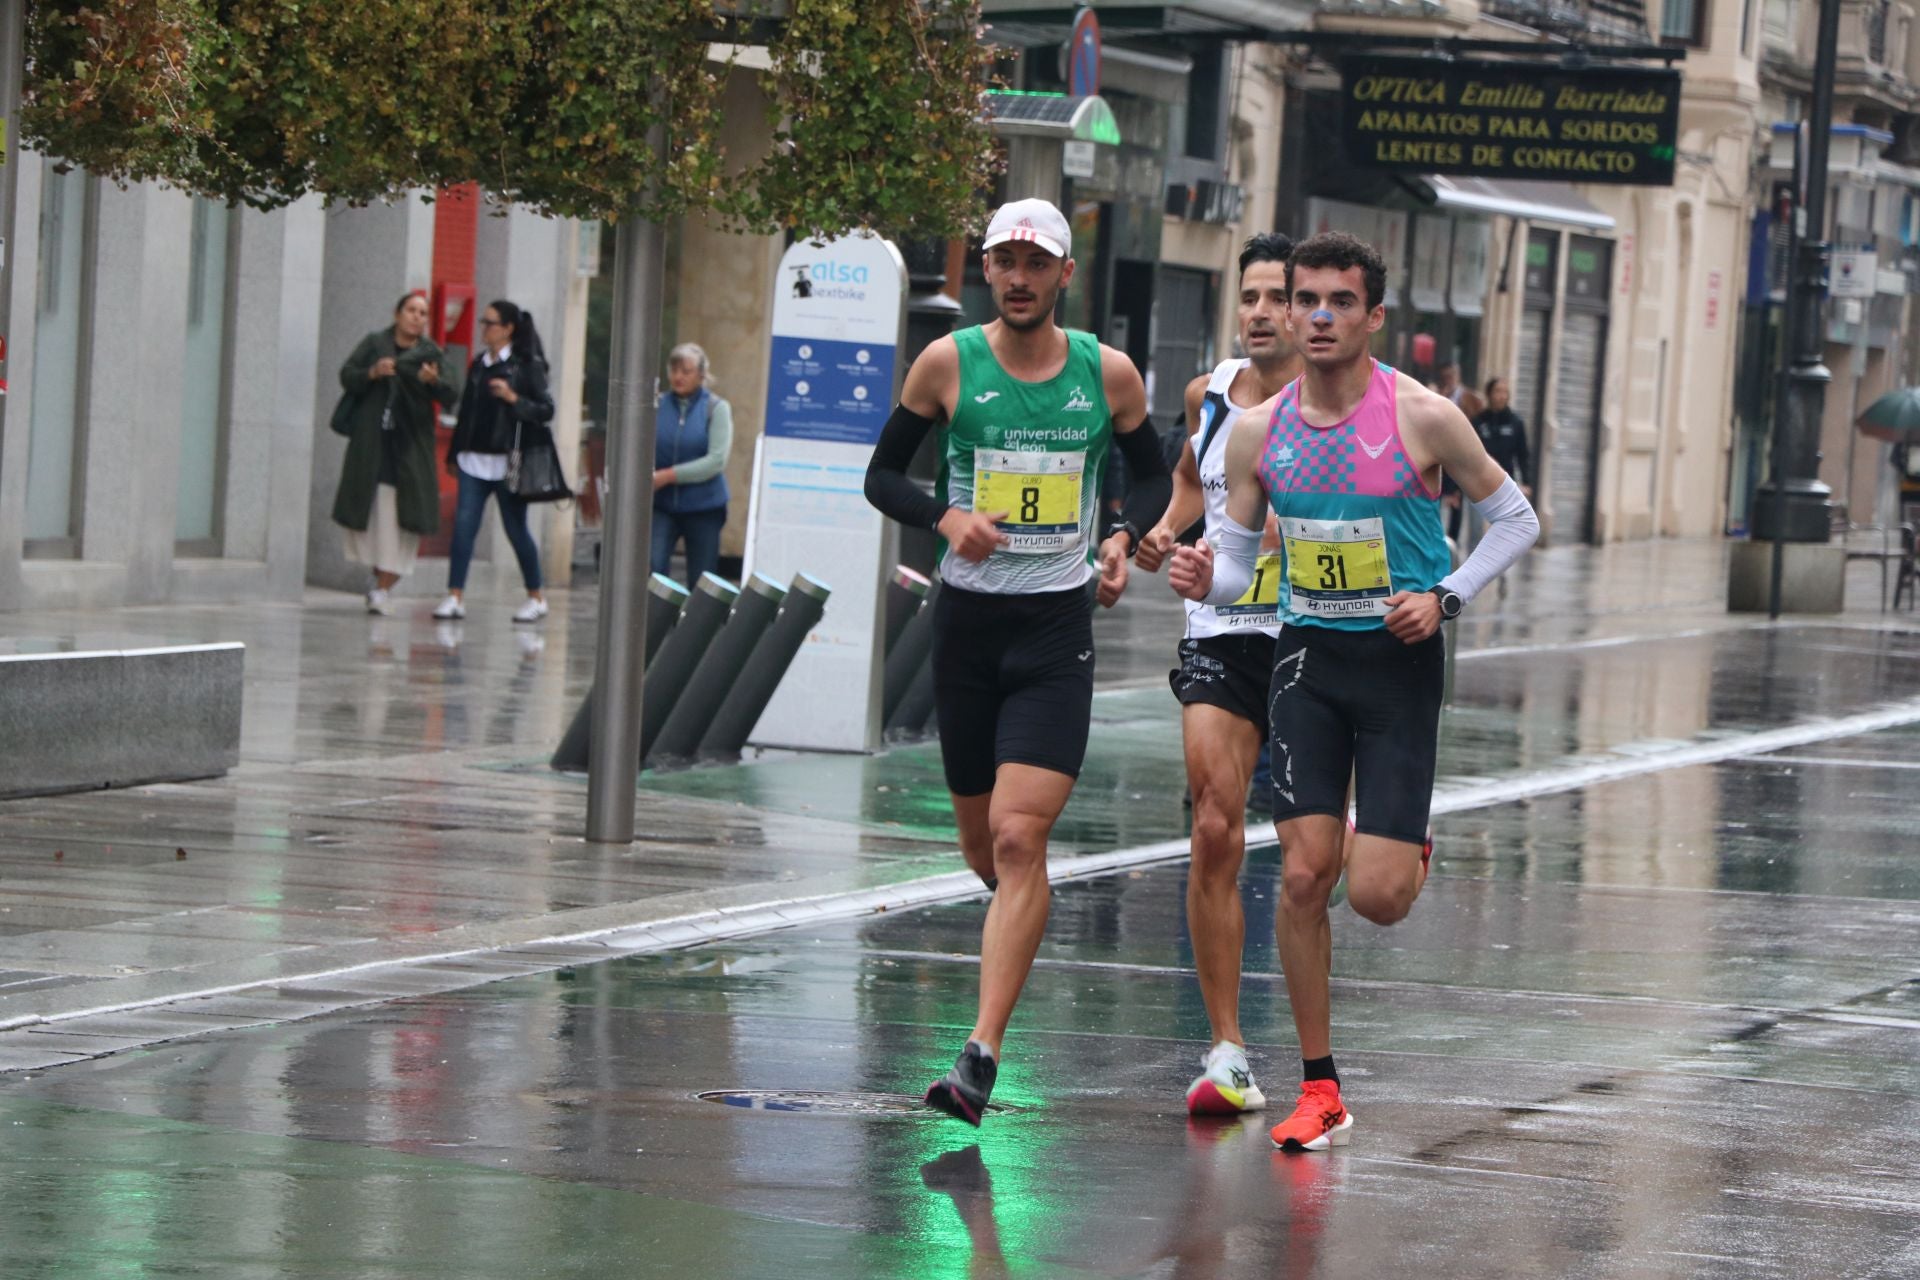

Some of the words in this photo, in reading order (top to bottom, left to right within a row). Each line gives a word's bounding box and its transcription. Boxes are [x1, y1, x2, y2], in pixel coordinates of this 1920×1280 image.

[1353, 75, 1446, 101] OPTICA
[1460, 82, 1545, 109] Emilia
[1555, 88, 1667, 114] Barriada
[1358, 110, 1481, 134] APARATOS
[1488, 115, 1551, 139] PARA
[1561, 120, 1659, 144] SORDOS
[1376, 141, 1461, 162] LENTES
[1472, 145, 1502, 167] DE
[1513, 148, 1635, 173] CONTACTO
[812, 260, 868, 284] alsa
[1004, 427, 1088, 440] universidad
[1004, 440, 1016, 449] de
[1021, 487, 1039, 522] 8
[1014, 536, 1063, 545] HYUNDAI
[1317, 554, 1347, 589] 31
[1323, 600, 1374, 611] HYUNDAI
